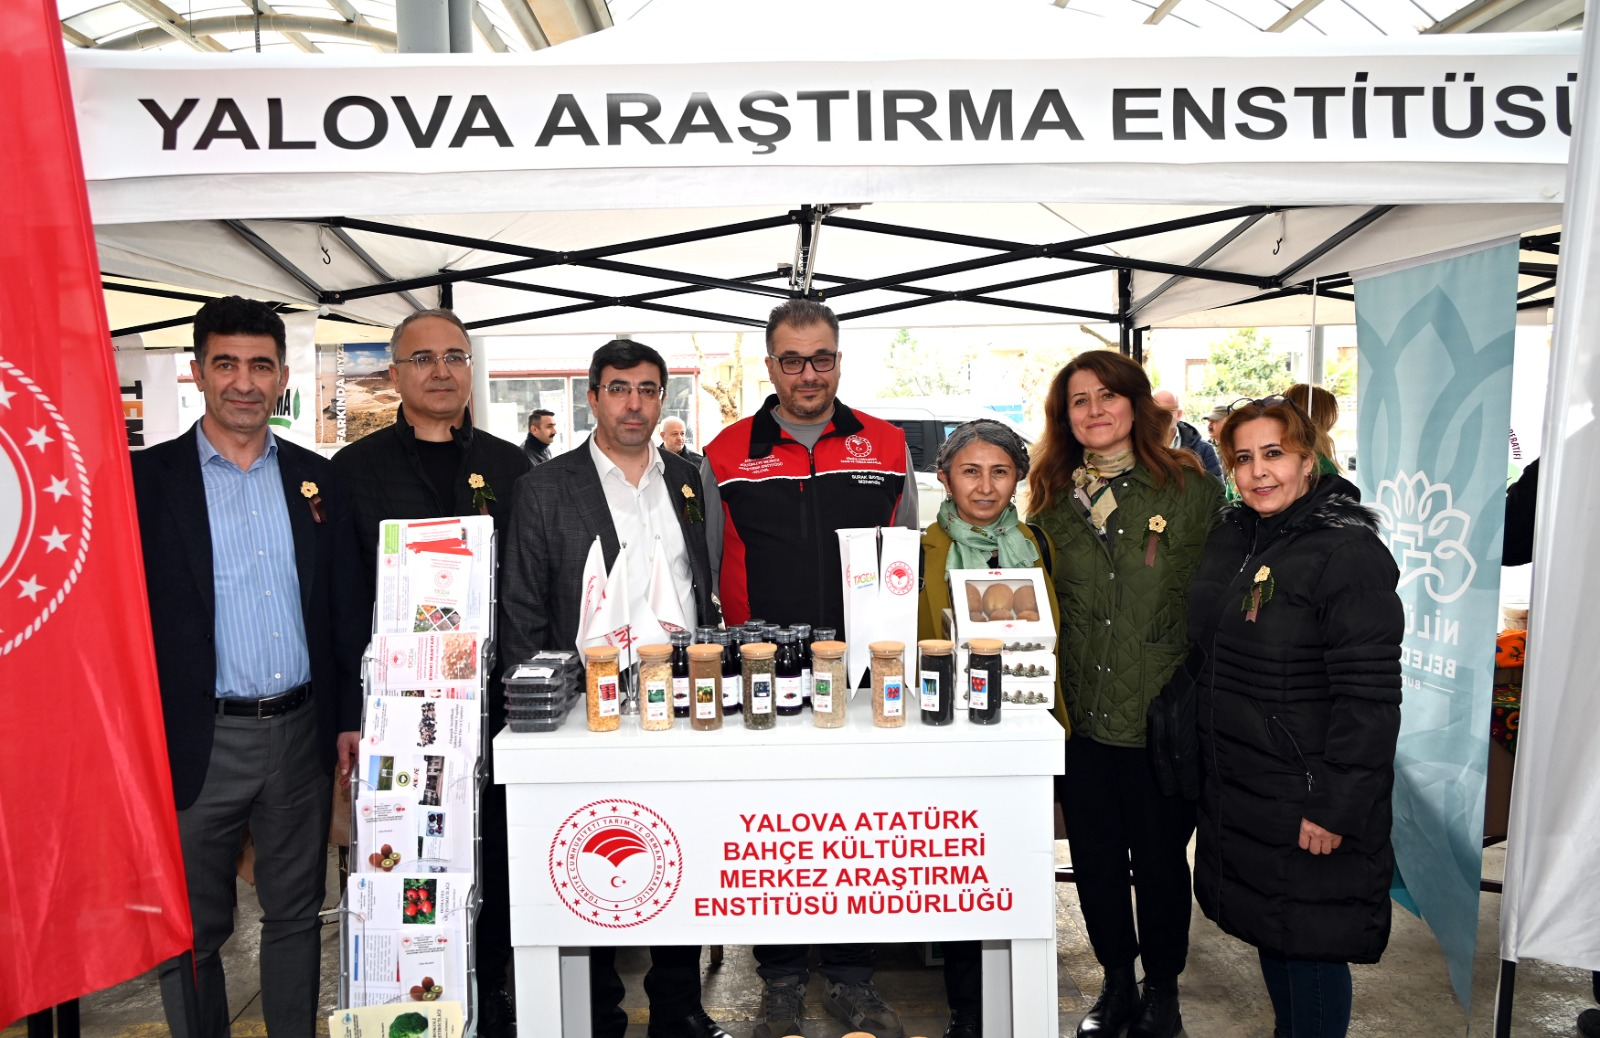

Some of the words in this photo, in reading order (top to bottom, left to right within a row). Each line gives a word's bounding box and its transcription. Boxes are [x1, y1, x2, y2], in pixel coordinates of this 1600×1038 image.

[138, 94, 514, 151] YALOVA
[534, 88, 1084, 153] ARAŞTIRMA
[335, 378, 346, 442] FARKINDA
[739, 812, 847, 833] YALOVA
[854, 806, 979, 832] ATATÜRK
[569, 821, 601, 872] CUMHURİYETİ
[602, 818, 631, 827] TARIM
[633, 823, 644, 833] VE
[644, 832, 663, 861] ORMAN
[723, 840, 814, 865] BAHÇE
[822, 832, 986, 860] KÜLTÜRLERİ
[719, 867, 828, 889] MERKEZ
[835, 864, 989, 891] ARAŞTIRMA
[694, 891, 838, 917] ENSTİTÜSÜ
[847, 887, 1013, 915] MÜDÜRLÜĞÜ
